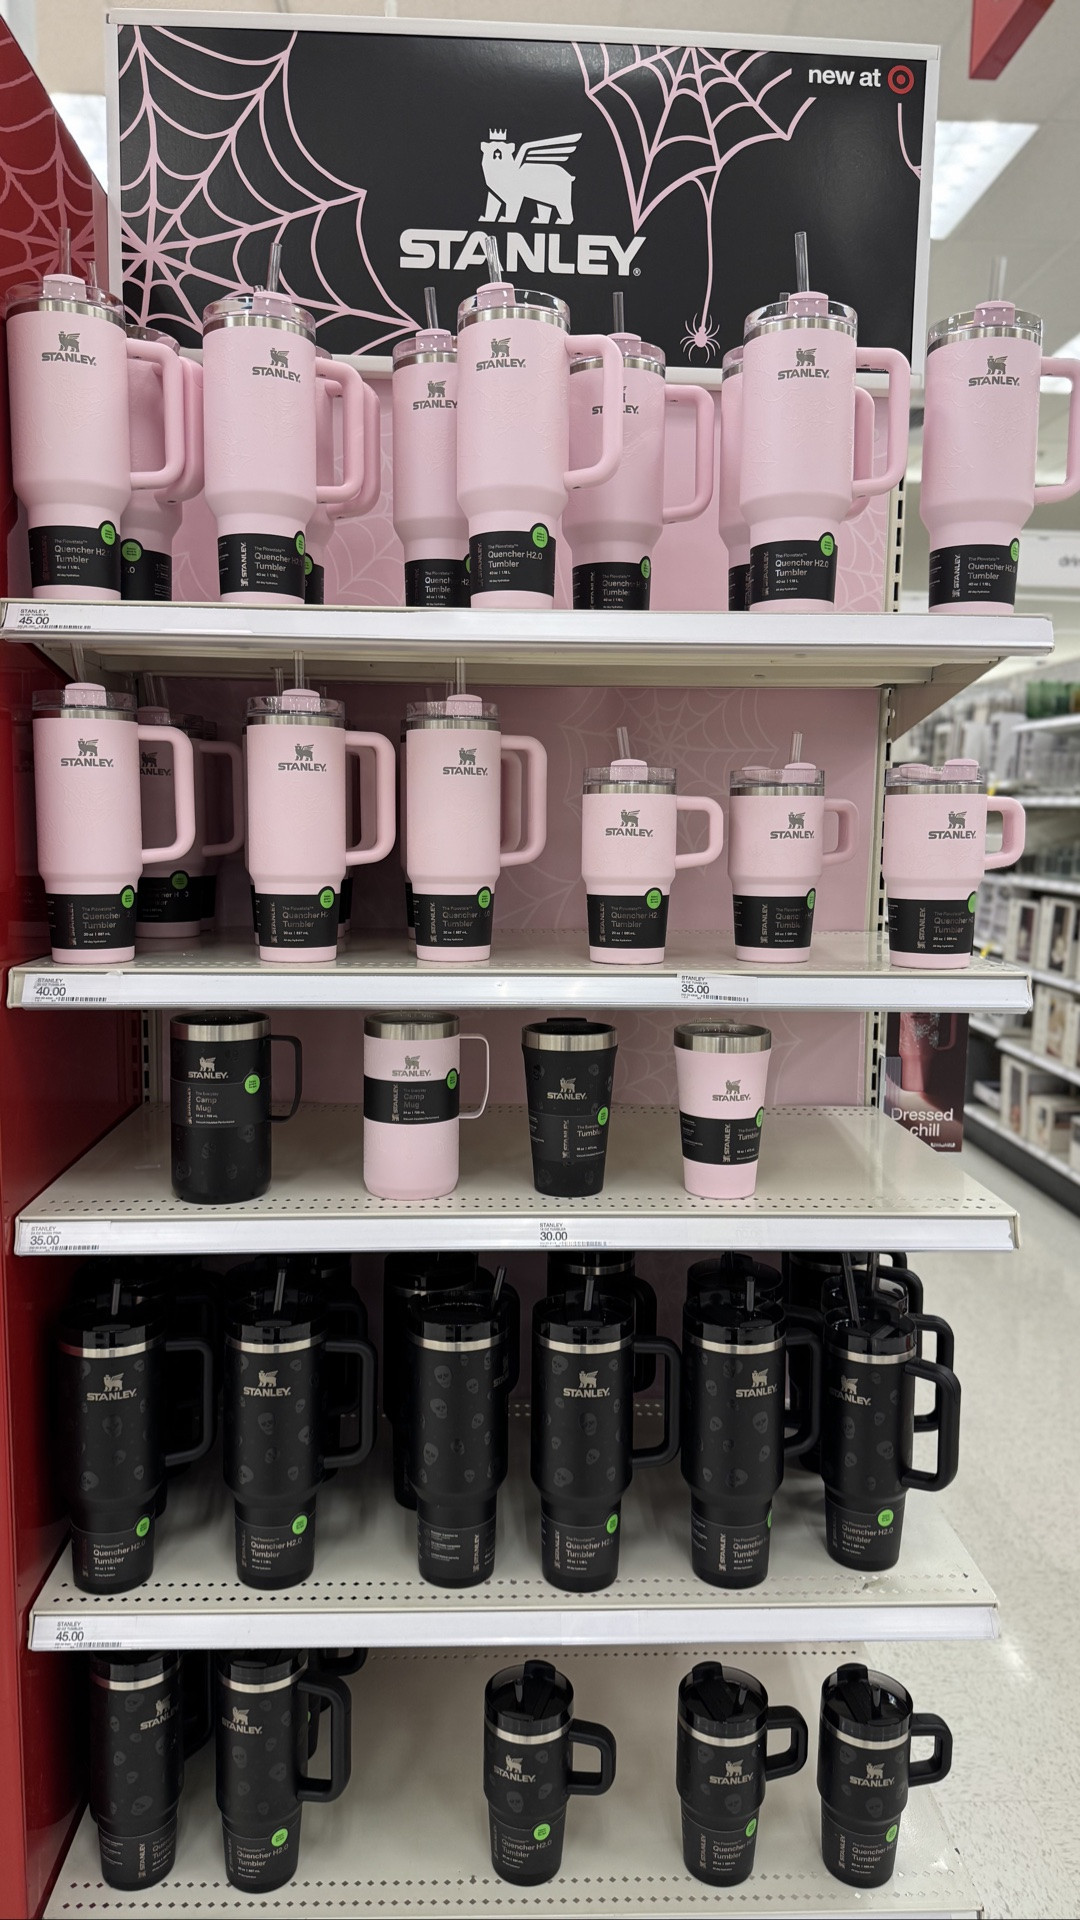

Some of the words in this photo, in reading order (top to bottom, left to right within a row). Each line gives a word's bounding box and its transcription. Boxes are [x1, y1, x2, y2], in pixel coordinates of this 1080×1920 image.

[808, 67, 854, 86] new
[860, 68, 881, 88] at
[54, 545, 94, 555] Quencher
[54, 554, 89, 564] Tumbler
[254, 552, 291, 563] Quencher
[487, 550, 525, 560] Quencher
[526, 551, 543, 560] H2.0
[254, 561, 287, 572] Tumbler
[488, 560, 519, 569] Tumbler
[775, 559, 813, 568] Quencher
[814, 560, 829, 568] H2.0
[968, 562, 1005, 571] Quencher
[775, 569, 808, 577] Tumbler
[953, 554, 961, 589] STANLEY
[968, 572, 1000, 580] Tumbler
[18, 616, 50, 625] 45.00
[282, 911, 320, 919] Quencher
[442, 911, 478, 919] Quencher
[611, 911, 647, 919] Quencher
[82, 921, 117, 929] Tumbler
[282, 920, 314, 928] Tumbler
[442, 920, 473, 928] Tumbler
[611, 920, 642, 928] Tumbler
[933, 926, 964, 934] Tumbler
[36, 986, 67, 996] 40.00
[681, 983, 710, 994] 35.00
[195, 1096, 218, 1105] Camp
[195, 1104, 212, 1113] Mug
[403, 1101, 420, 1110] Mug
[891, 1107, 954, 1121] Dressed
[910, 1123, 940, 1137] chill
[29, 1235, 60, 1246] 35.00
[539, 1231, 568, 1241] 30.00
[841, 1524, 877, 1537] Quencher
[878, 1526, 894, 1536] H2.0
[842, 1531, 872, 1544] Tumbler
[250, 1540, 285, 1550] Quencher
[286, 1536, 303, 1548] H2.0
[565, 1541, 601, 1550] Quencher
[93, 1547, 130, 1557] Quencher
[250, 1549, 280, 1558] Tumbler
[565, 1549, 595, 1558] Tumbler
[732, 1549, 760, 1558] Tumbler
[93, 1556, 125, 1565] Tumbler
[55, 1631, 84, 1642] 45.00
[501, 1839, 535, 1851] Quencher
[536, 1839, 552, 1850] H2.0
[712, 1843, 746, 1853] Quencher
[236, 1850, 272, 1860] Quencher
[272, 1843, 289, 1856] H2.0
[501, 1845, 530, 1858] Tumbler
[851, 1846, 886, 1855] Quencher
[712, 1852, 741, 1860] Tumbler
[851, 1853, 881, 1863] Tumbler
[237, 1858, 267, 1867] Tumbler
